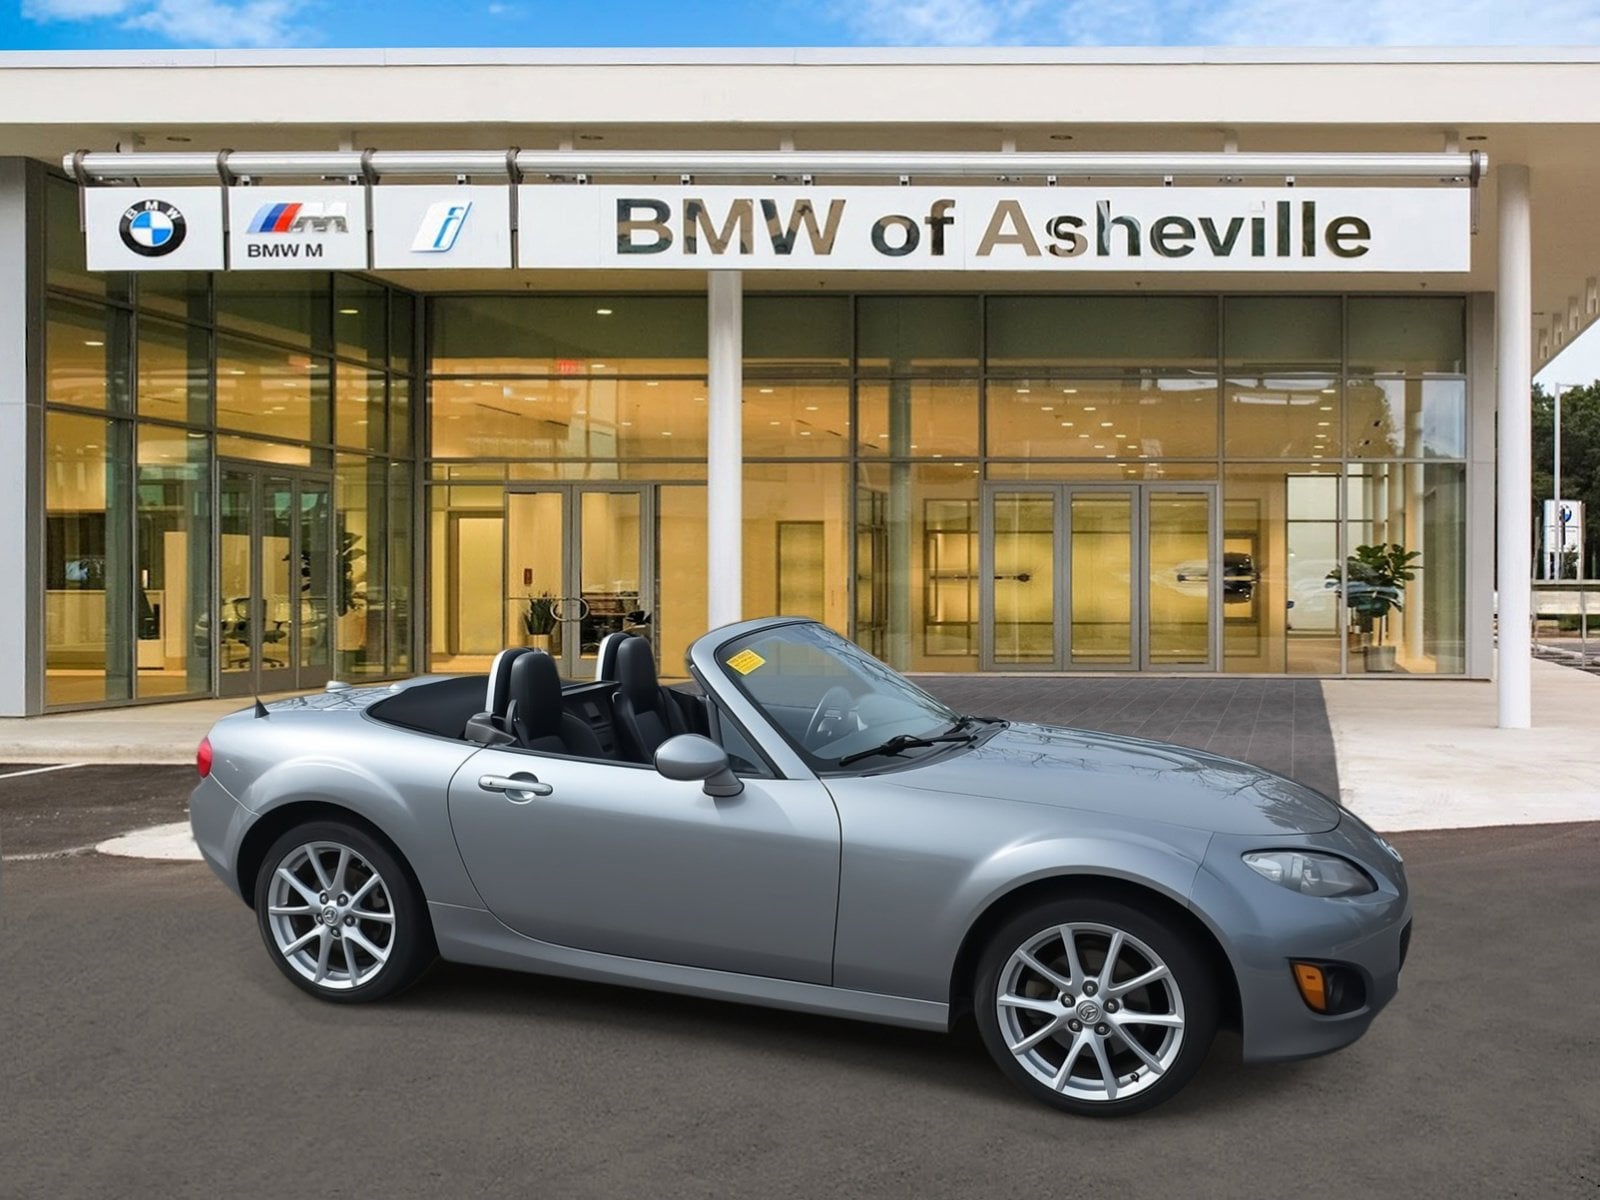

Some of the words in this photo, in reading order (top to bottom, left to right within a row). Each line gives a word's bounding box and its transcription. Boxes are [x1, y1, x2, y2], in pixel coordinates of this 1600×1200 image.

[125, 200, 181, 220] BMW
[616, 198, 846, 255] BMW
[871, 199, 956, 257] of
[975, 199, 1372, 258] Asheville
[247, 243, 300, 258] BMW
[305, 243, 323, 258] M
